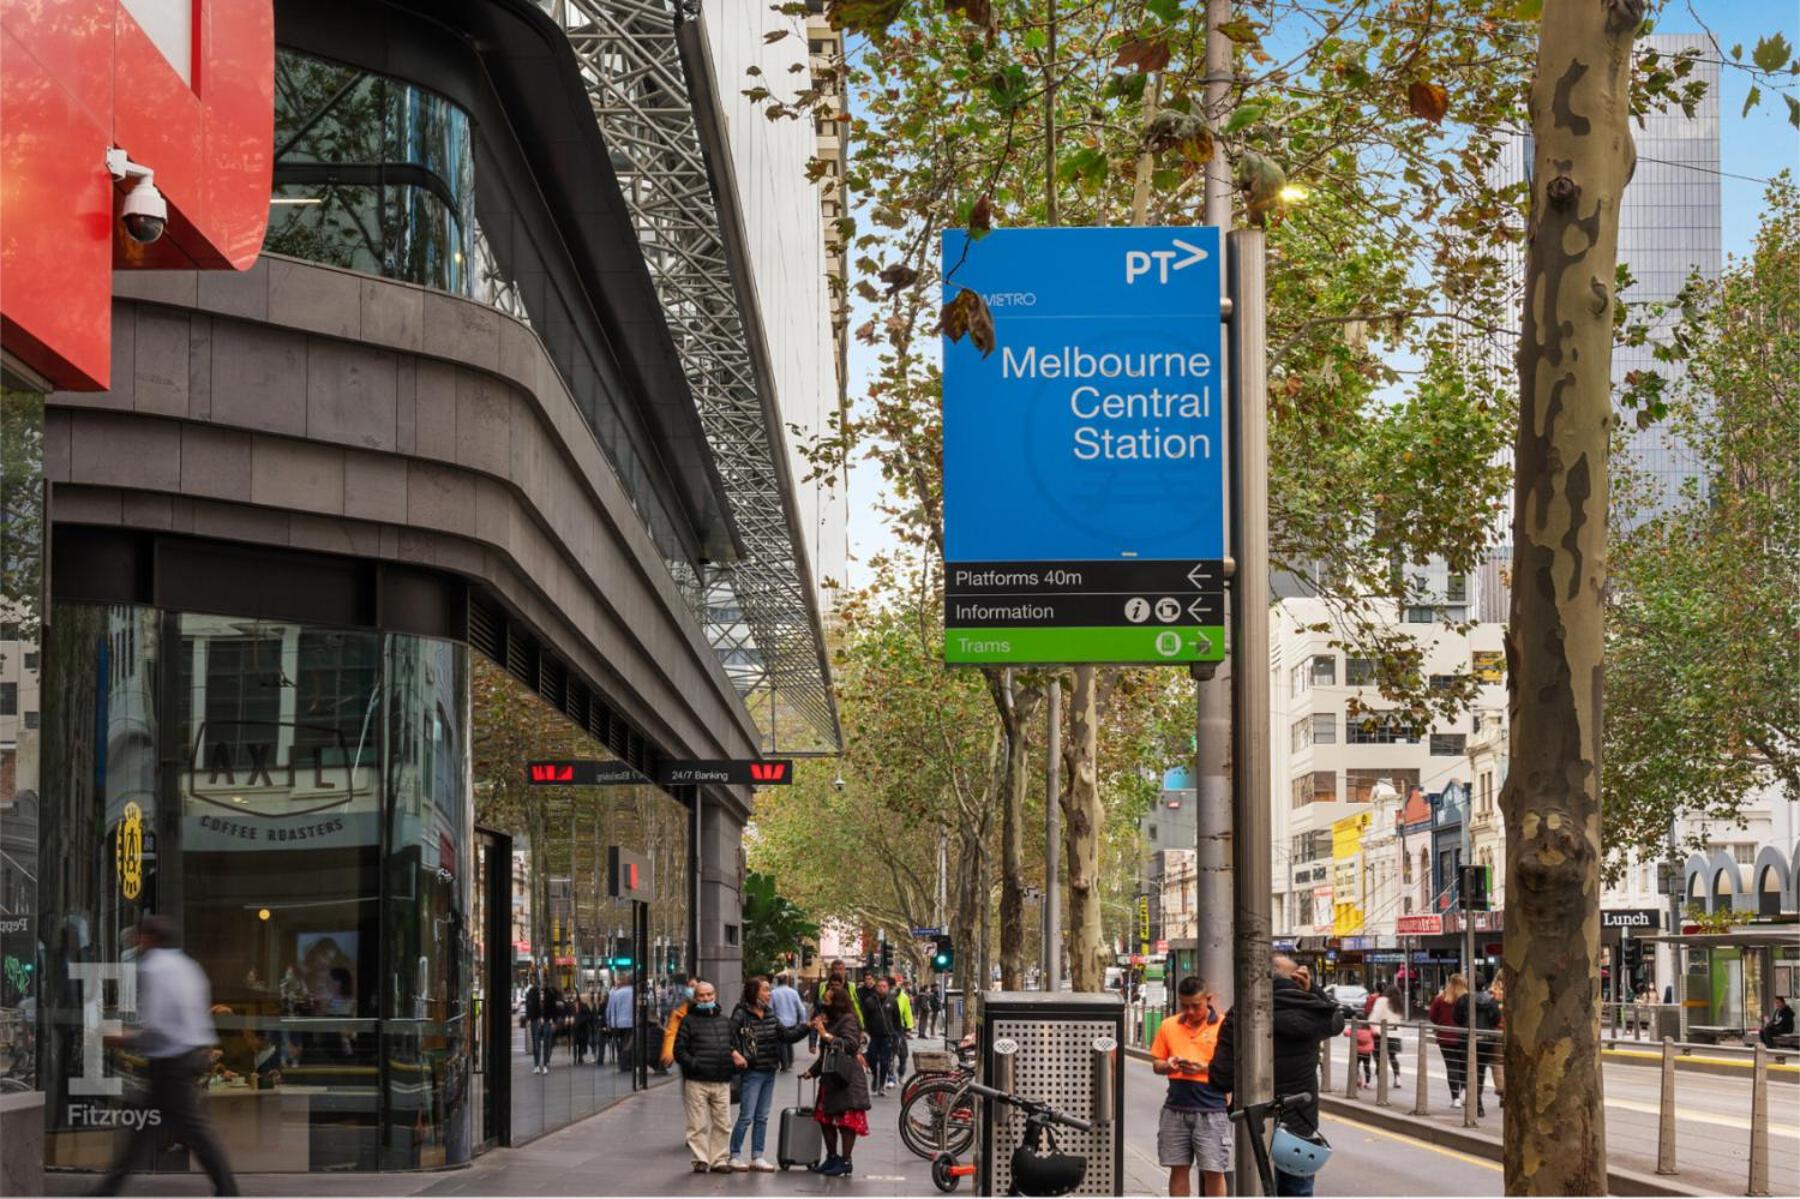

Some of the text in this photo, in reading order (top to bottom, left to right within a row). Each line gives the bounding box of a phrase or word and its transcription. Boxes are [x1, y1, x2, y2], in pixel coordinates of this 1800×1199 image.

[1002, 346, 1211, 379] Melbourne
[1070, 385, 1211, 419] Central
[1073, 426, 1211, 460] Station
[955, 569, 1083, 587] Platforms 40m
[955, 603, 1055, 620] Information
[957, 636, 1011, 654] Trams
[208, 742, 336, 789] AXIL
[671, 769, 729, 782] 24/7 Banking
[199, 815, 345, 842] COFFEE ROASTERS
[1603, 911, 1650, 926] Lunch
